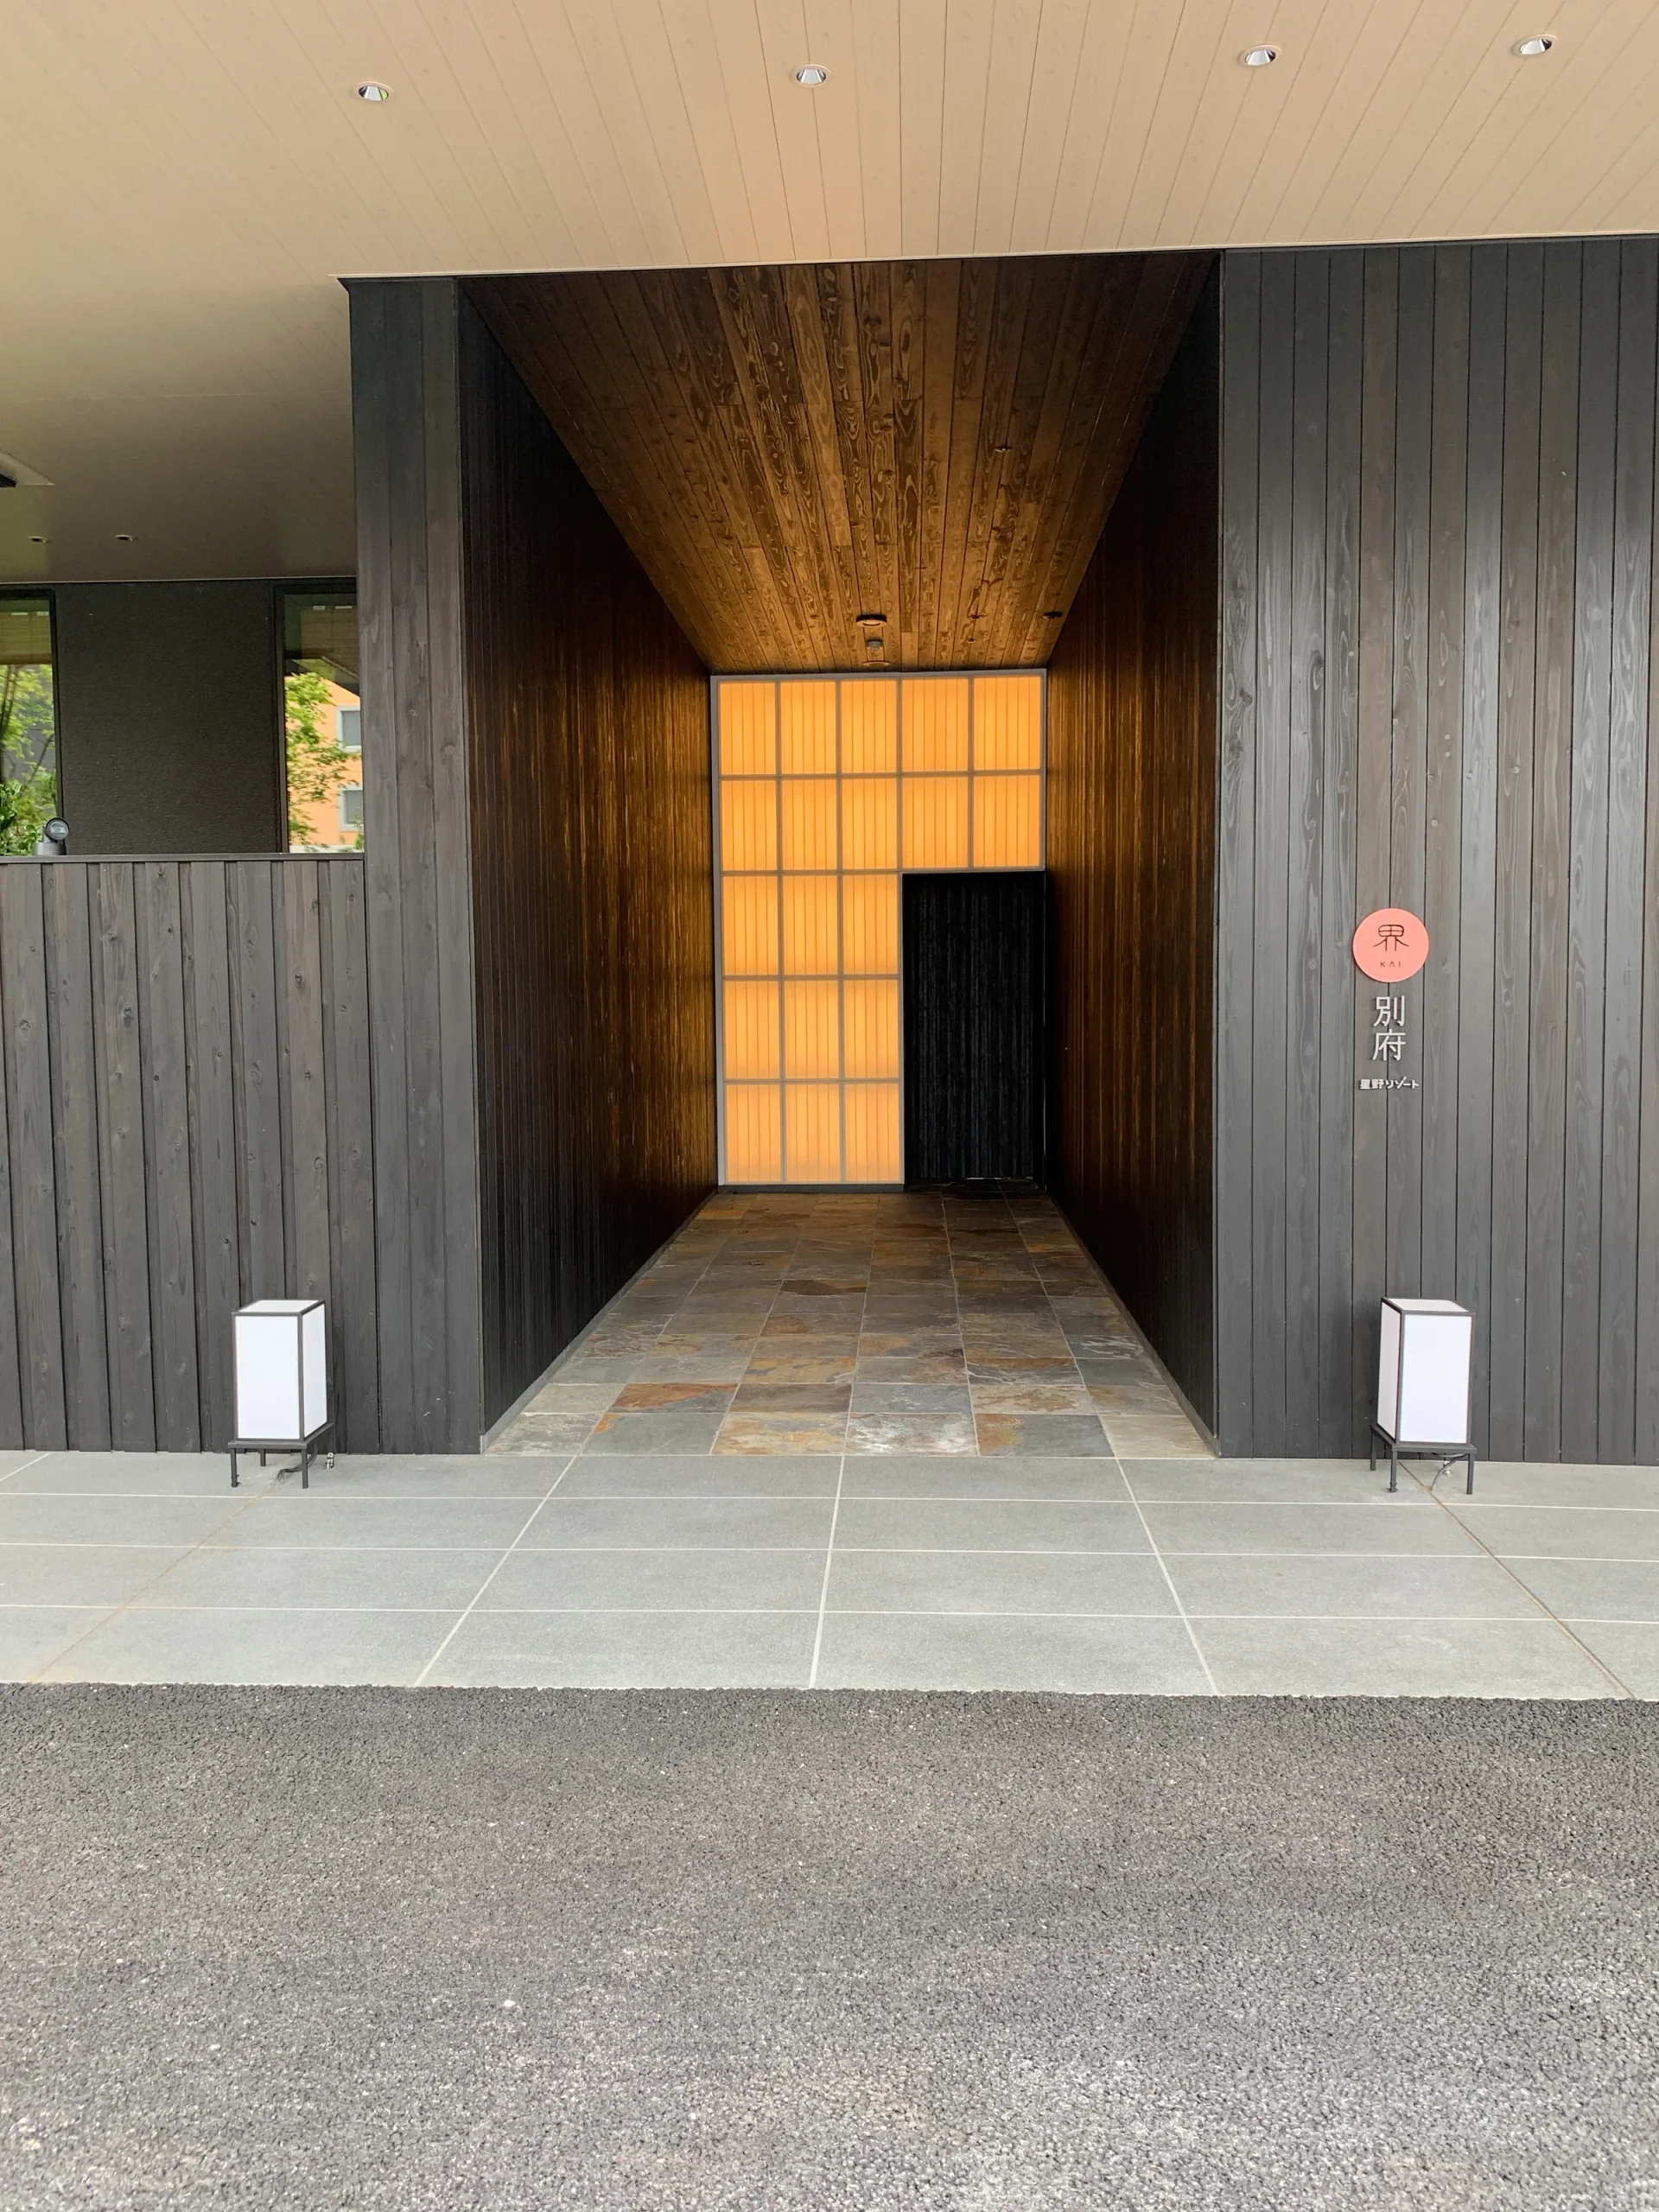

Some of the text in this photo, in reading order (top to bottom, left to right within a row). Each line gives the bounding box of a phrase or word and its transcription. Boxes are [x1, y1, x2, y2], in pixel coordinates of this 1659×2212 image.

[1372, 924, 1409, 952] 界
[1372, 995, 1406, 1061] 別府
[1359, 1077, 1420, 1090] 星野リゾート
